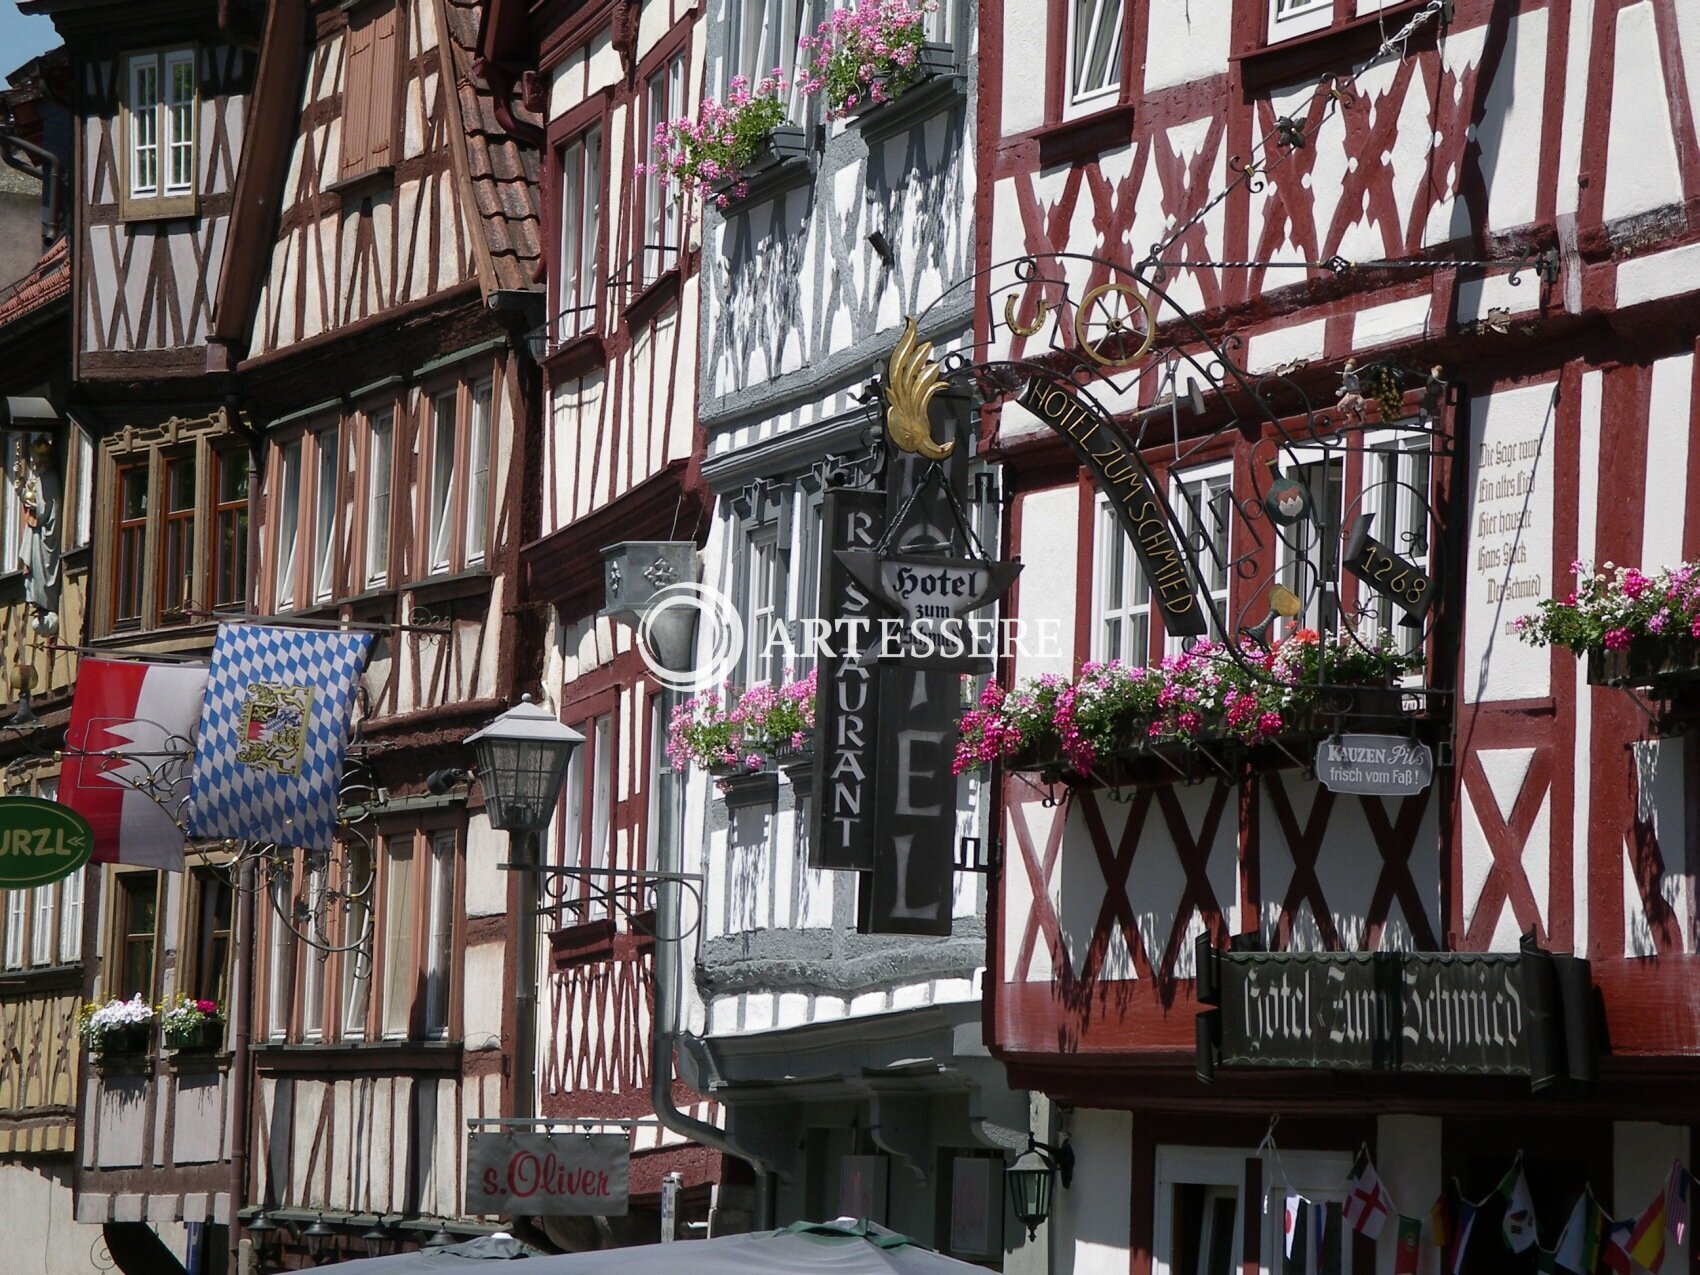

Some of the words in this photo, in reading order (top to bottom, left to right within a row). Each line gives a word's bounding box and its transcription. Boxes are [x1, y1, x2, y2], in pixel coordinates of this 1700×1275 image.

[1028, 378, 1100, 452] HOTEL
[1091, 440, 1144, 503] ZUM
[1478, 443, 1493, 468] Die
[1495, 441, 1517, 467] Sage
[1478, 478, 1493, 503] Ein
[1496, 474, 1515, 499] altes
[1478, 511, 1497, 540] Hier
[1361, 546, 1426, 603] 1268
[1478, 546, 1500, 576] Hans
[892, 566, 978, 600] Hotel
[1505, 574, 1541, 600] Schmied
[915, 604, 950, 619] zum
[831, 512, 874, 848] RSTAURANT
[1328, 744, 1386, 763] KAUZEN
[1387, 744, 1424, 766] Pils
[1330, 767, 1362, 782] frisch
[1365, 770, 1390, 783] vom
[1244, 966, 1313, 1051] Hotel
[1402, 966, 1522, 1054] Schmied
[483, 1150, 610, 1198] s.Oliver
